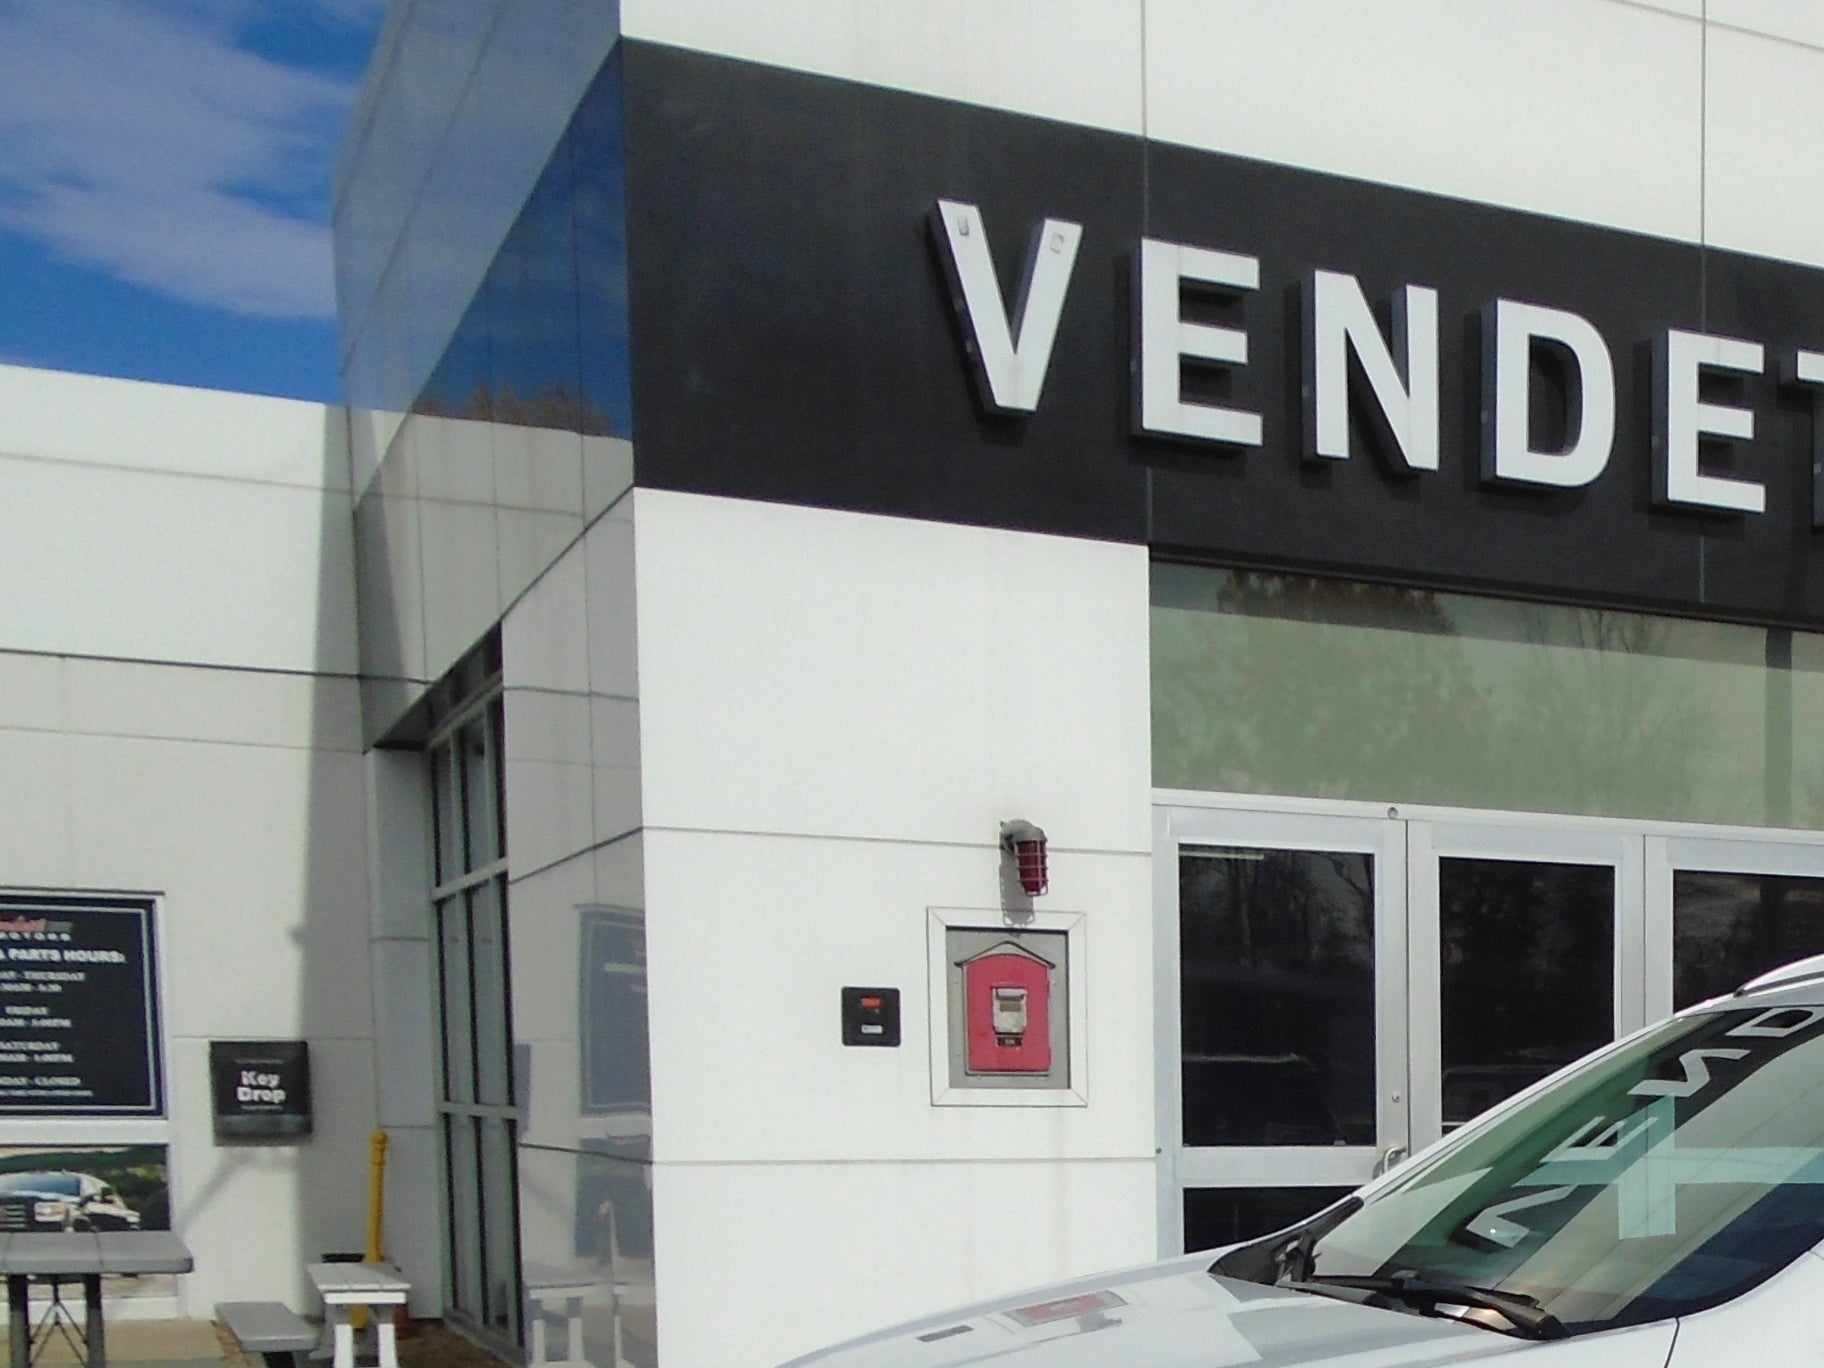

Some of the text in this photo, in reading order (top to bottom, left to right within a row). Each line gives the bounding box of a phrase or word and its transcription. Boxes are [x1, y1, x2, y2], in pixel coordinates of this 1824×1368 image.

[8, 948, 61, 962] PARTS
[241, 1070, 280, 1089] Key
[237, 1086, 287, 1104] Drop
